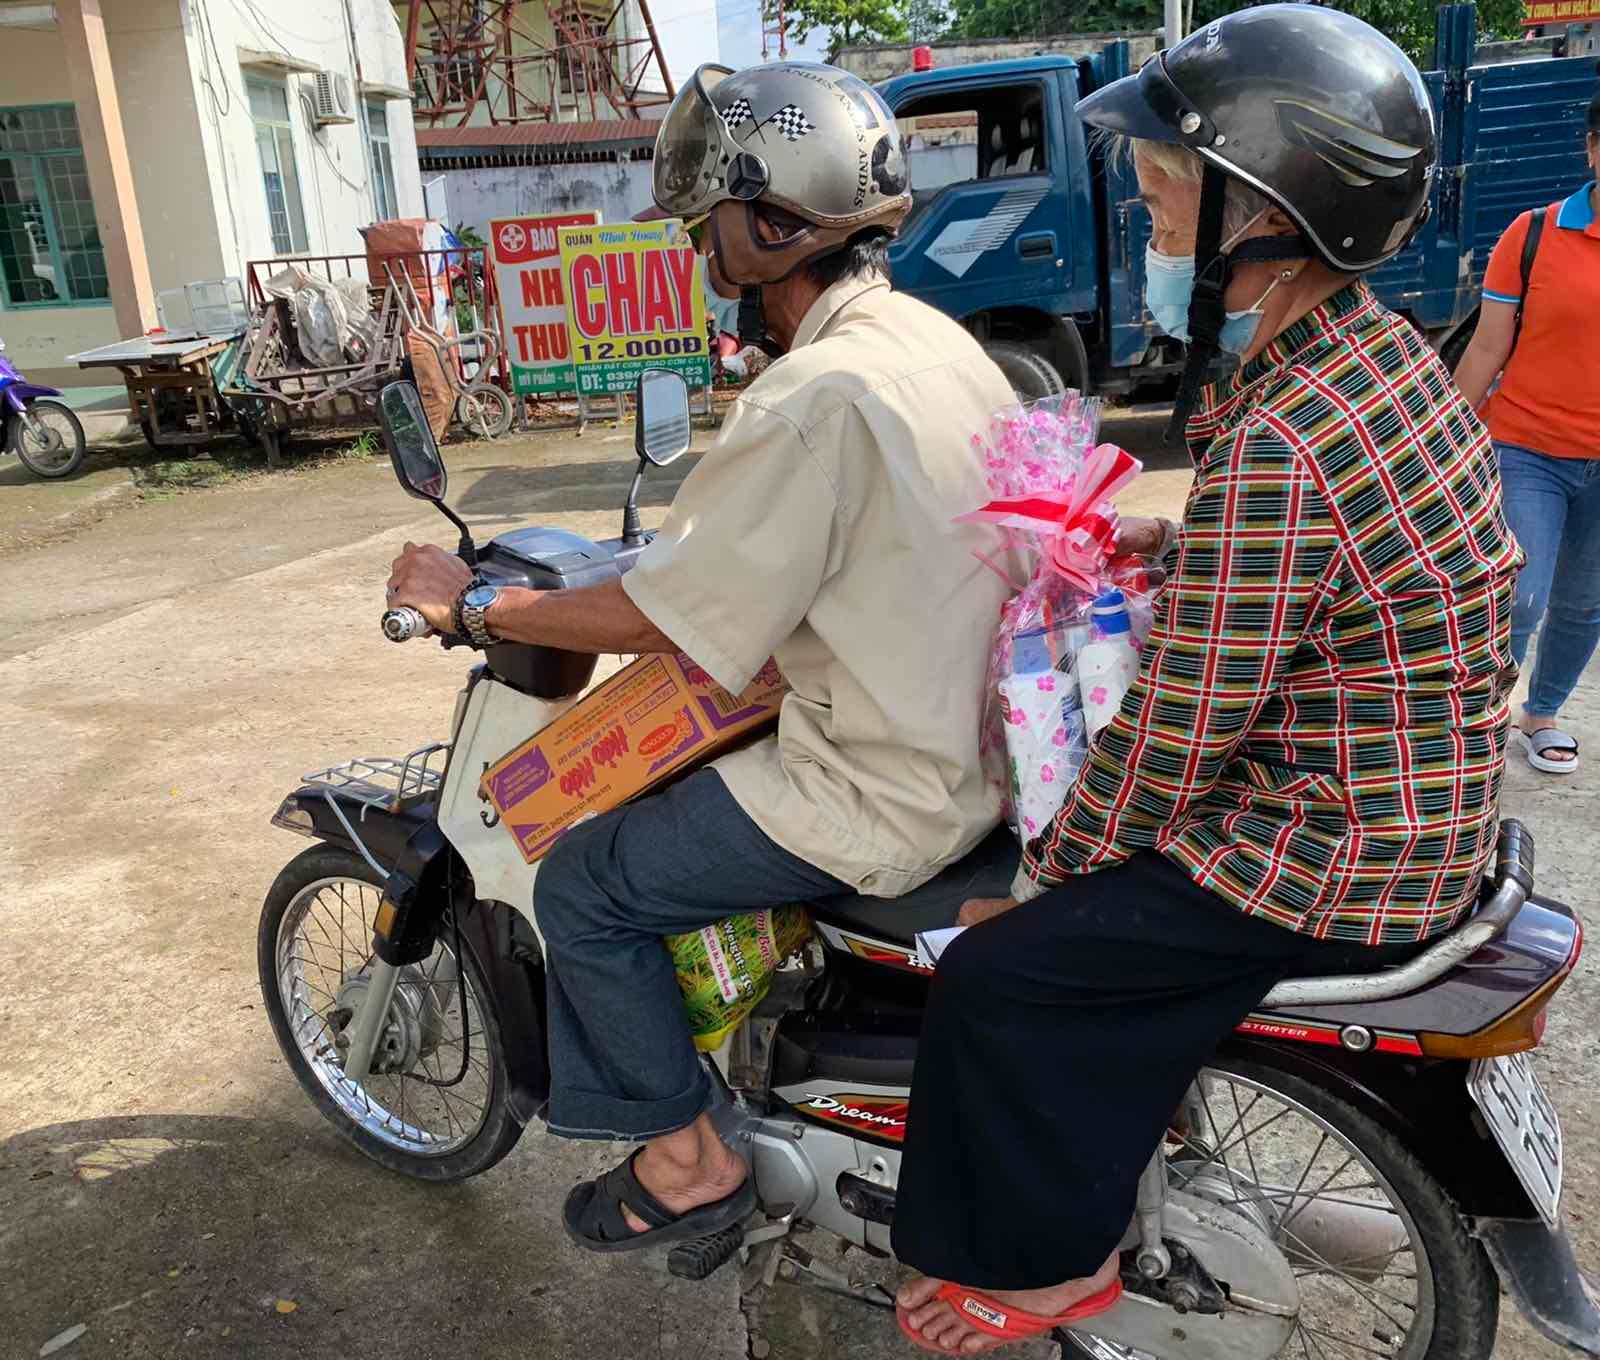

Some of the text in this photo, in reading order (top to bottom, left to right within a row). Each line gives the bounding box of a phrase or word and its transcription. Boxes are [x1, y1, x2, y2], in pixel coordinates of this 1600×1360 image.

[854, 148, 868, 208] ANDES
[519, 268, 565, 307] NH
[570, 248, 696, 339] CHAY
[578, 336, 702, 361] 12.000Đ
[1241, 1022, 1308, 1037] STARTER
[805, 1093, 906, 1126] Dream
